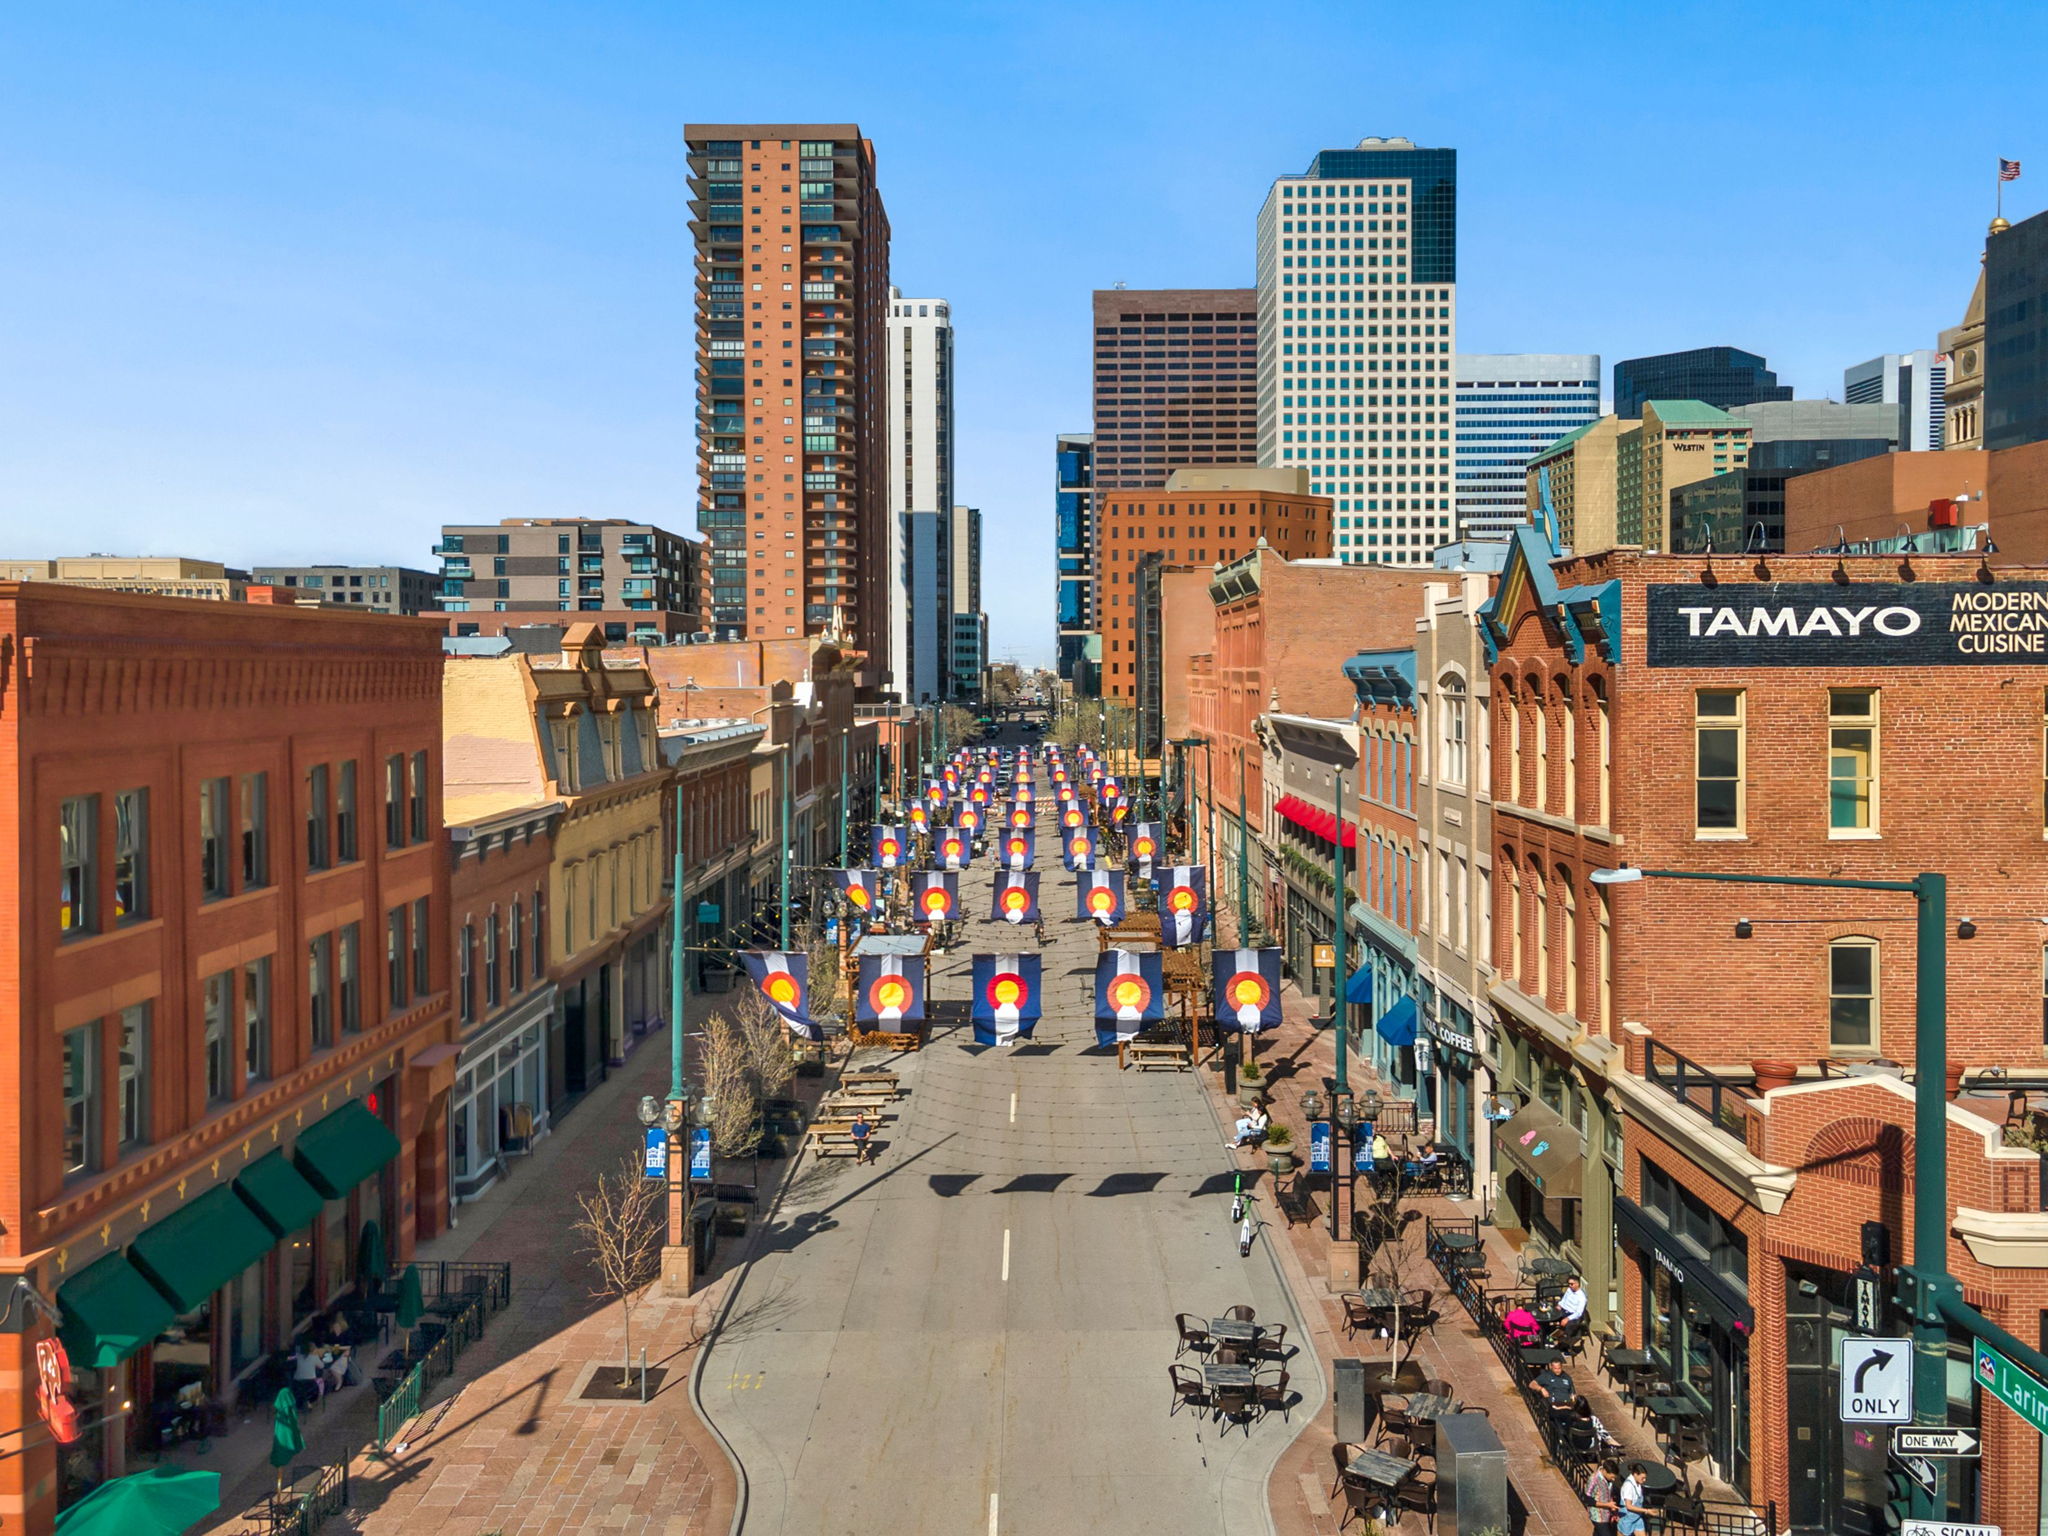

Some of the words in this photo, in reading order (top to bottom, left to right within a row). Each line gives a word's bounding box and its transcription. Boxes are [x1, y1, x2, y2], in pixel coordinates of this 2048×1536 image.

[1672, 443, 1705, 452] WESTIN
[1951, 592, 2048, 611] MODERN
[1678, 606, 1921, 636] TAMAYO
[1949, 613, 2048, 632] MEXICAN
[1957, 634, 2045, 654] CUISINE
[1440, 1027, 1474, 1053] COFFEE
[1654, 1247, 1684, 1283] TAMAYO
[1861, 1281, 1870, 1328] TAMAYO
[1852, 1398, 1900, 1414] ONLY
[1905, 1435, 1928, 1447] ONE
[1932, 1435, 1956, 1447] WAY
